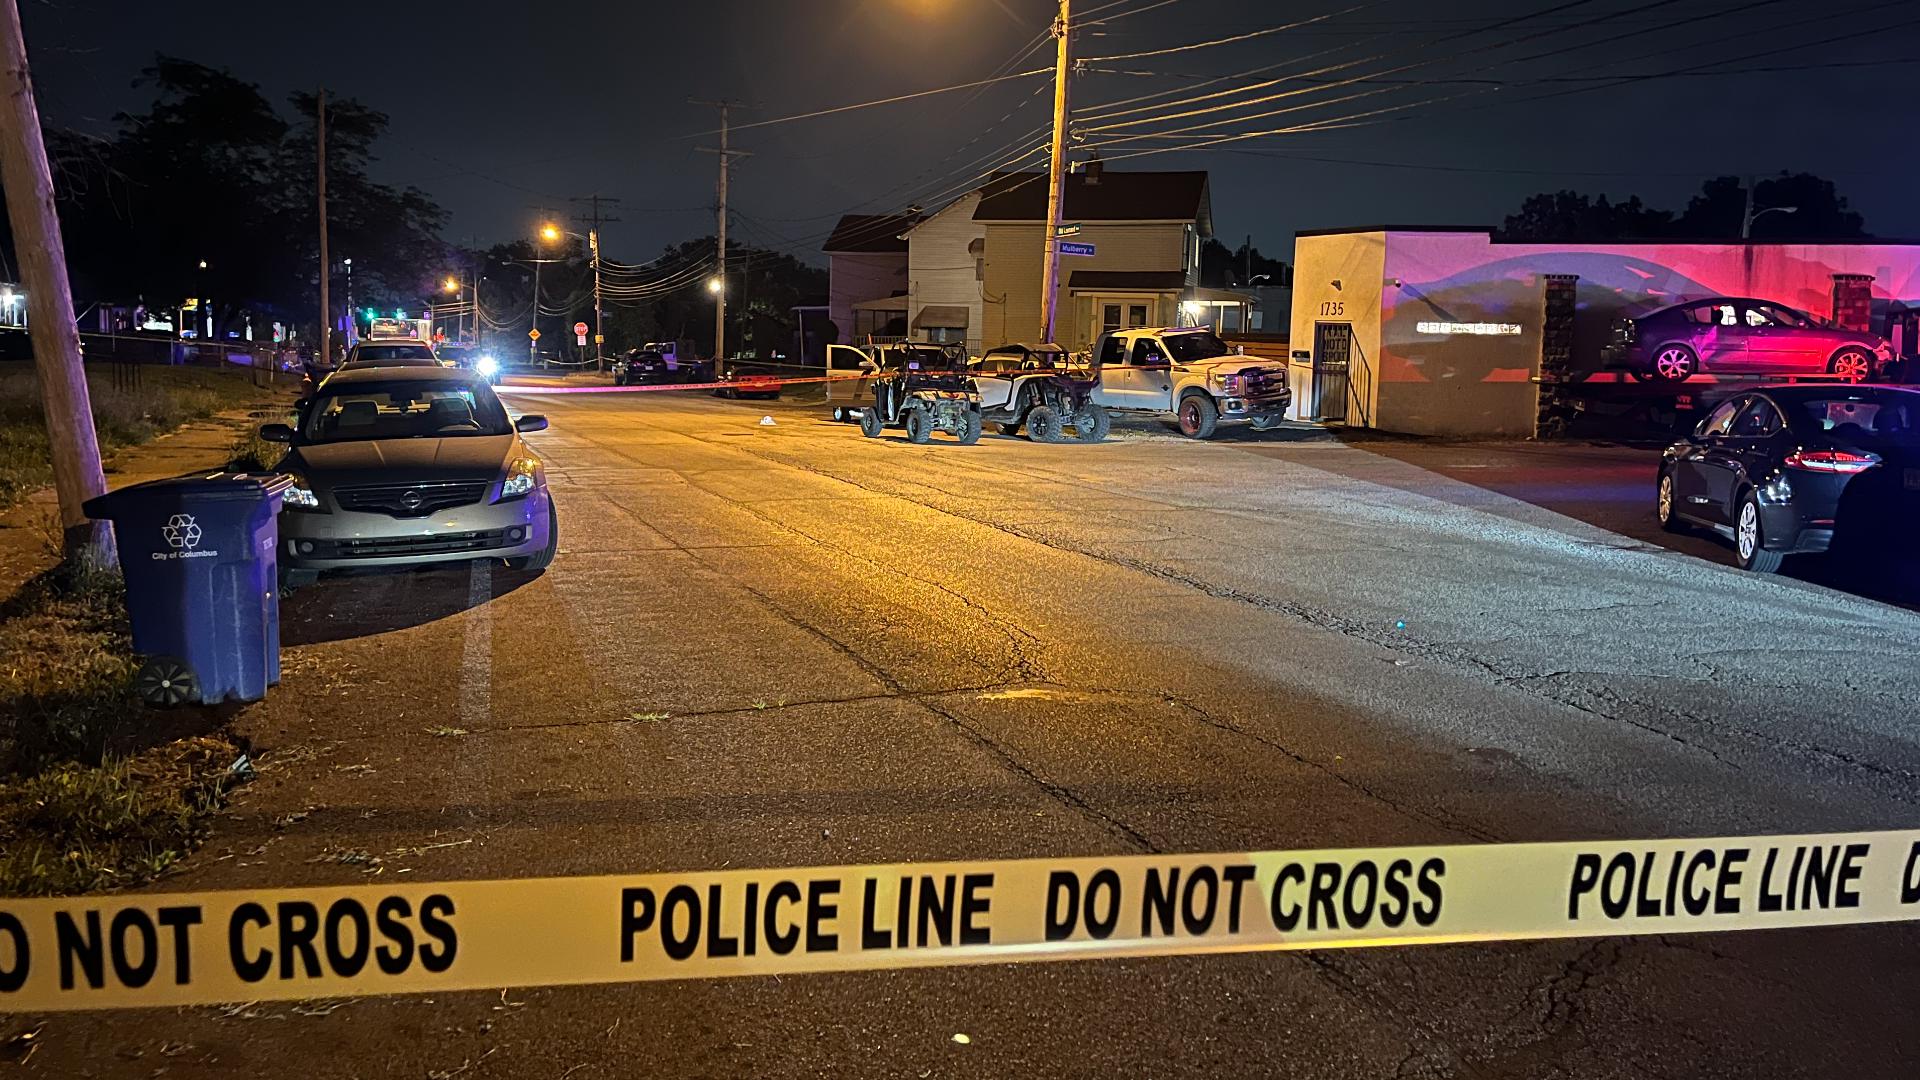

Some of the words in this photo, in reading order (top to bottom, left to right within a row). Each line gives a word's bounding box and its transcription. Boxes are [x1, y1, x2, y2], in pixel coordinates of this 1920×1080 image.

[1062, 244, 1087, 254] Mulberry
[1320, 302, 1344, 315] 1735
[152, 552, 167, 560] City
[178, 550, 217, 558] Columbus
[54, 905, 203, 992] NOT
[228, 894, 458, 983] CROSS
[620, 879, 841, 963] POLICE
[861, 873, 995, 950] LINE
[1045, 868, 1122, 942] DO
[1141, 865, 1257, 937] NOT
[1270, 857, 1446, 932] CROSS
[1568, 848, 1750, 920] POLICE
[1758, 843, 1871, 913] LINE
